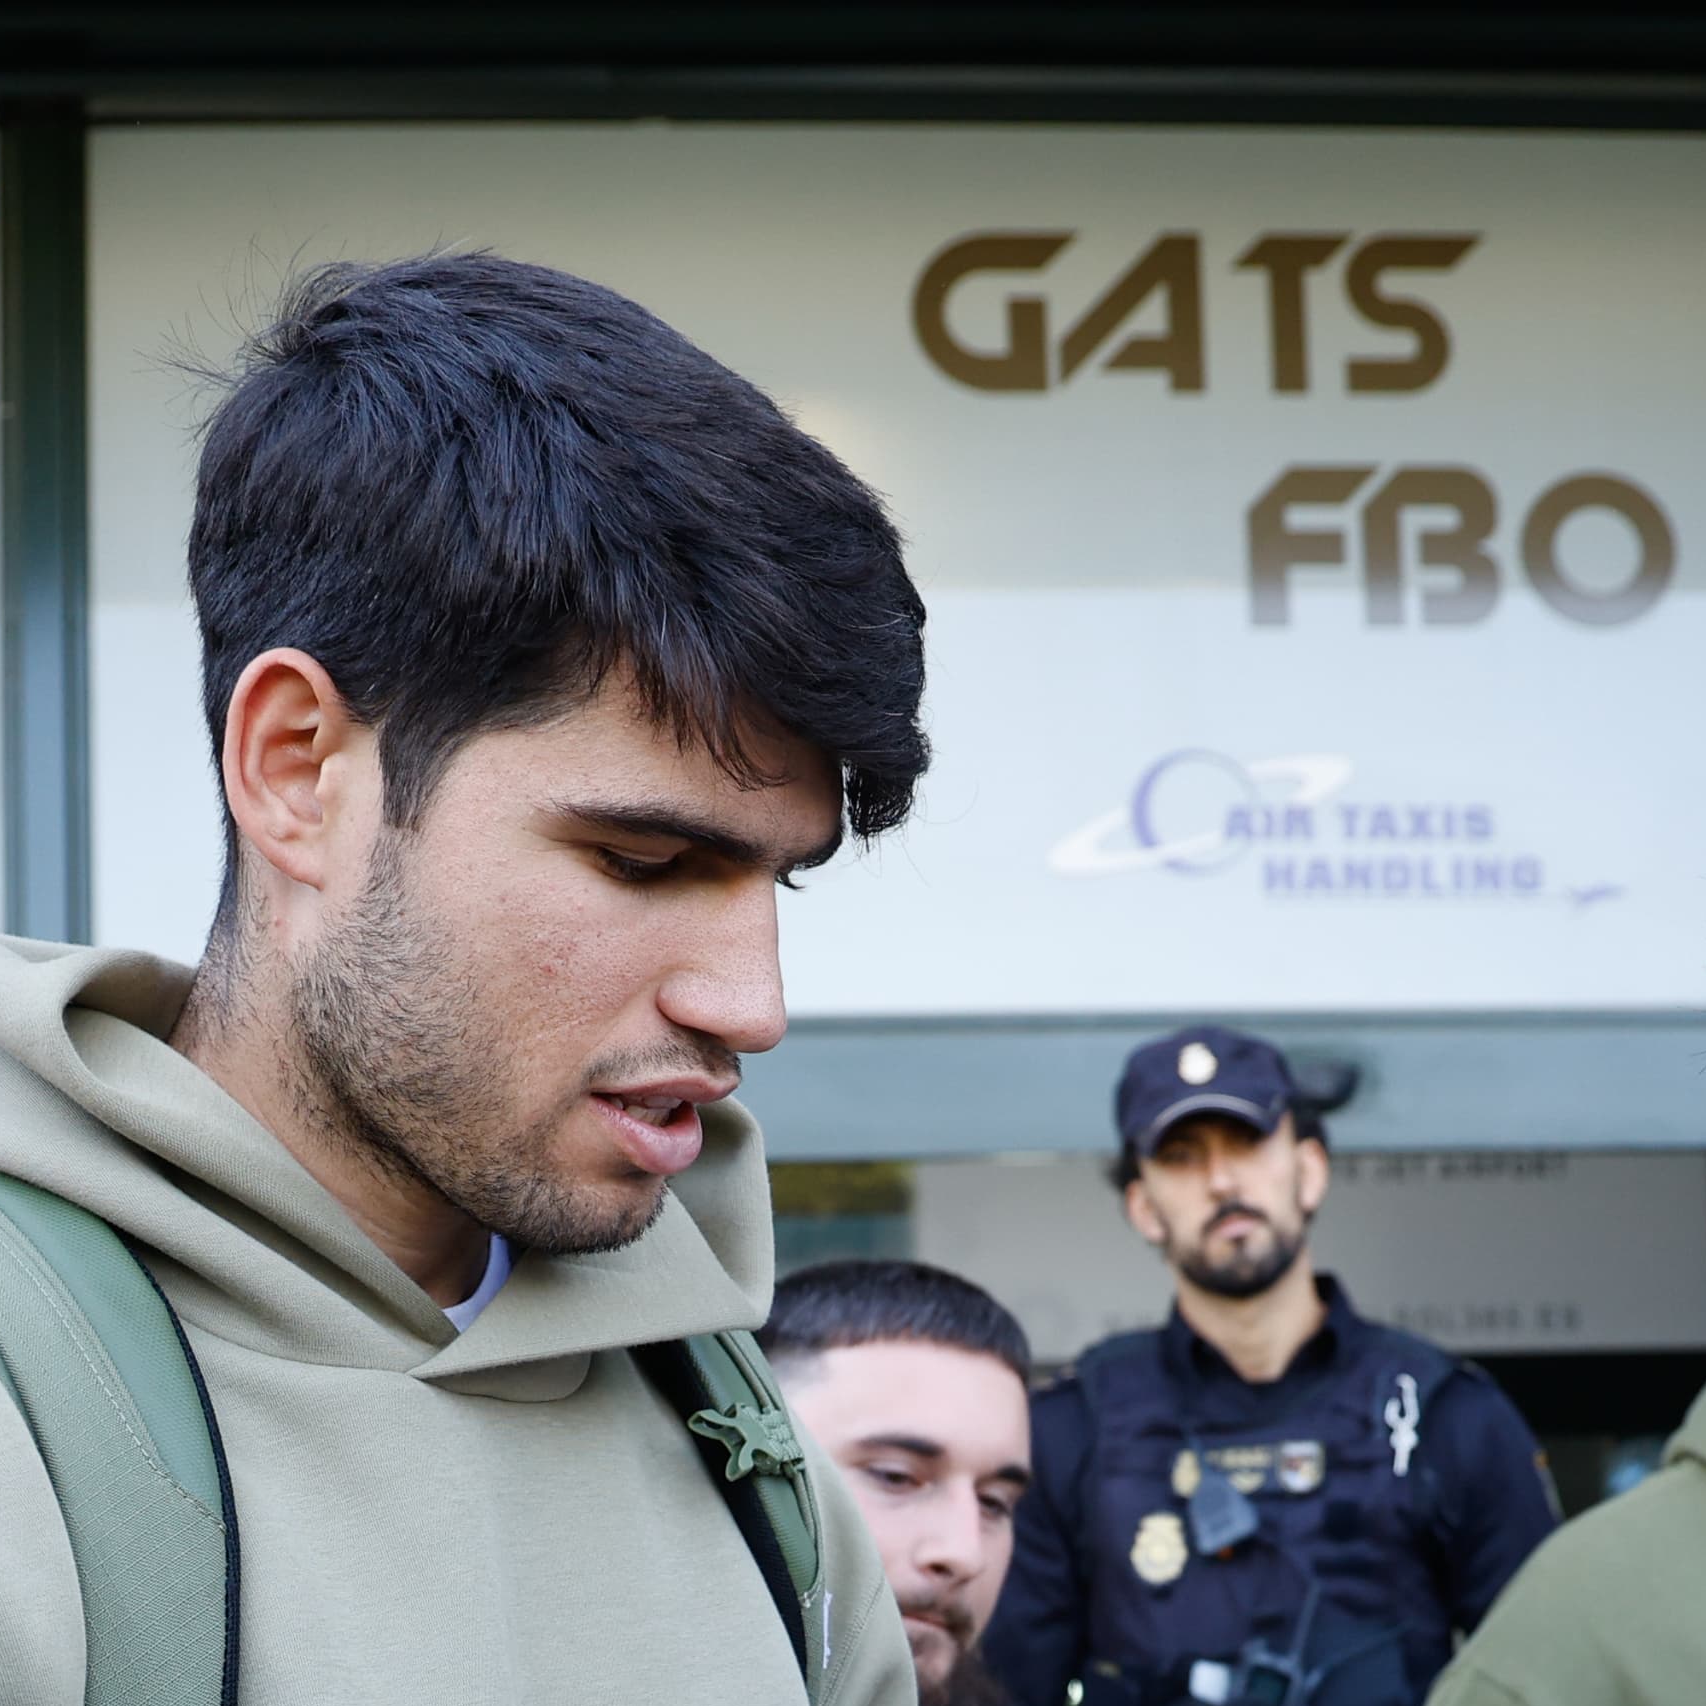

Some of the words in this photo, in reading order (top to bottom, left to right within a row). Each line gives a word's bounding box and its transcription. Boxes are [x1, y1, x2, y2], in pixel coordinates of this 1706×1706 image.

[911, 230, 1483, 394] GATS
[1246, 463, 1677, 627] FBO
[1224, 803, 1314, 842] AIR
[1338, 803, 1499, 842] TAXIS
[1262, 854, 1546, 895] HANDLING
